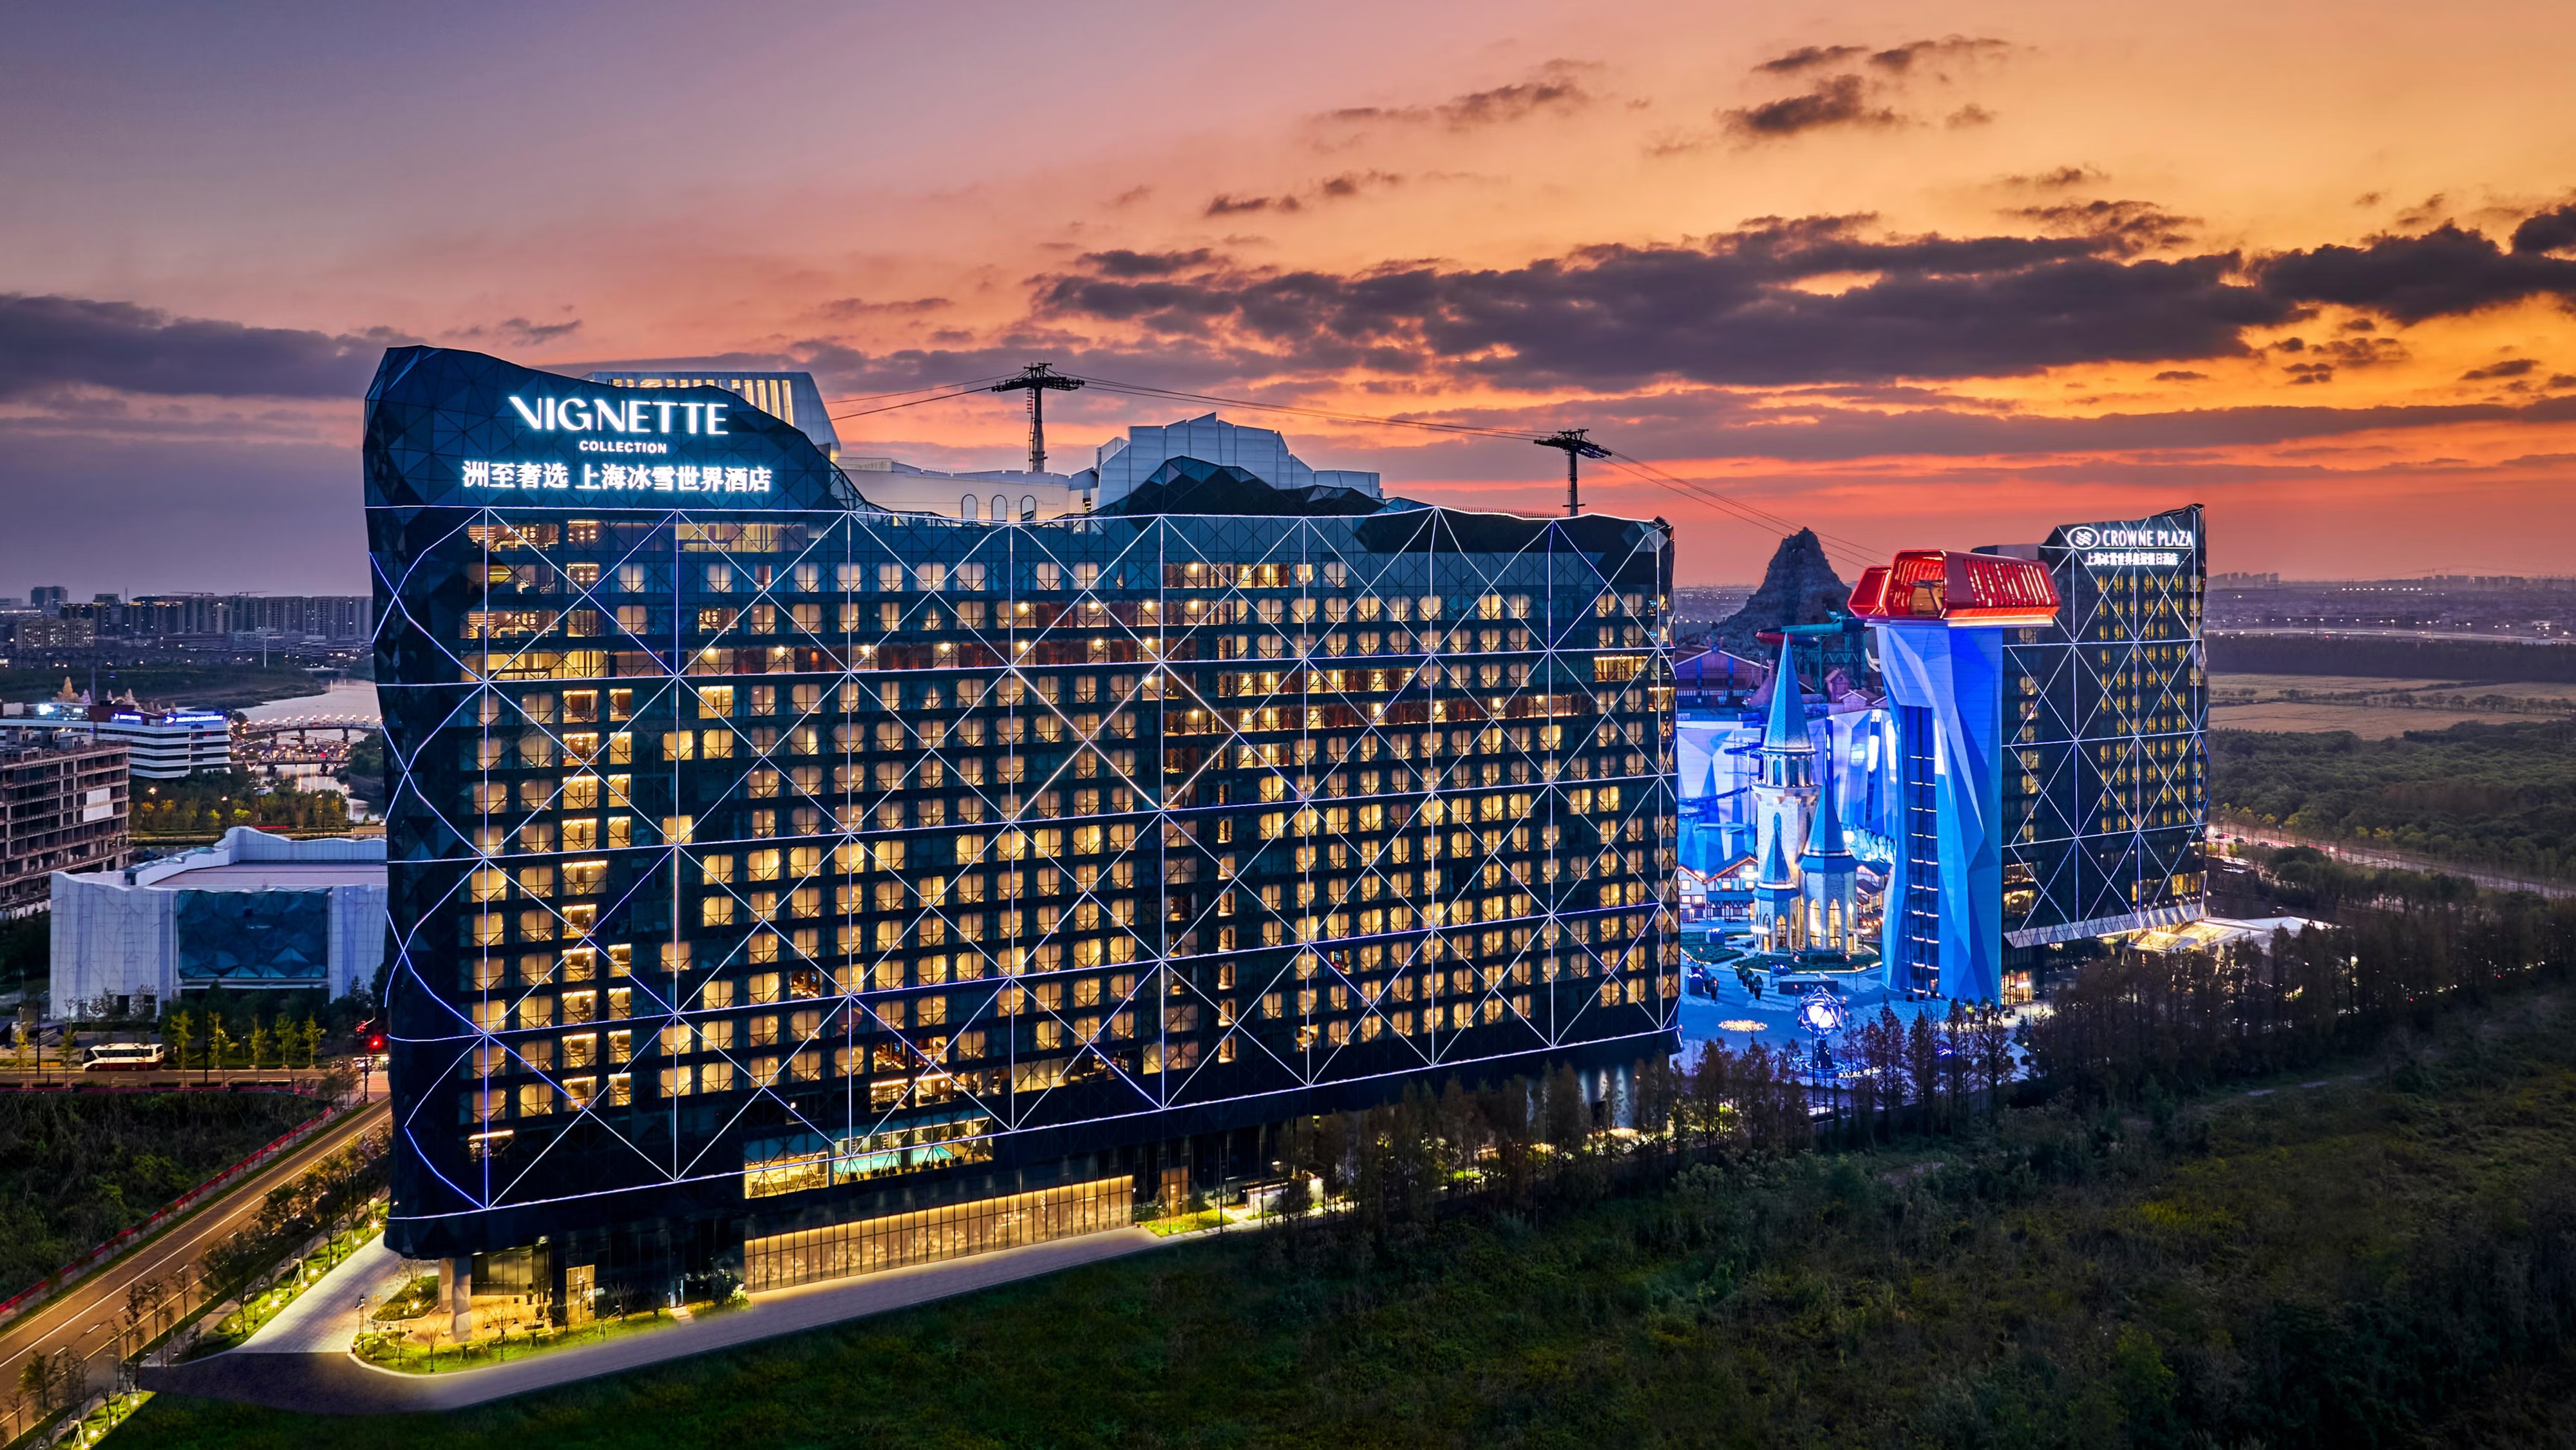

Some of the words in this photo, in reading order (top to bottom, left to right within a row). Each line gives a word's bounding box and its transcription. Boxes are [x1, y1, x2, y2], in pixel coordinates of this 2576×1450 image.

[508, 396, 728, 435] VIGNETTE
[579, 440, 667, 453] COLLECTION
[462, 460, 569, 490] 洲至奢选
[574, 464, 772, 493] 上海冰雪世界酒店
[2103, 530, 2154, 547] CROWNE
[2157, 530, 2194, 547] PLAZA
